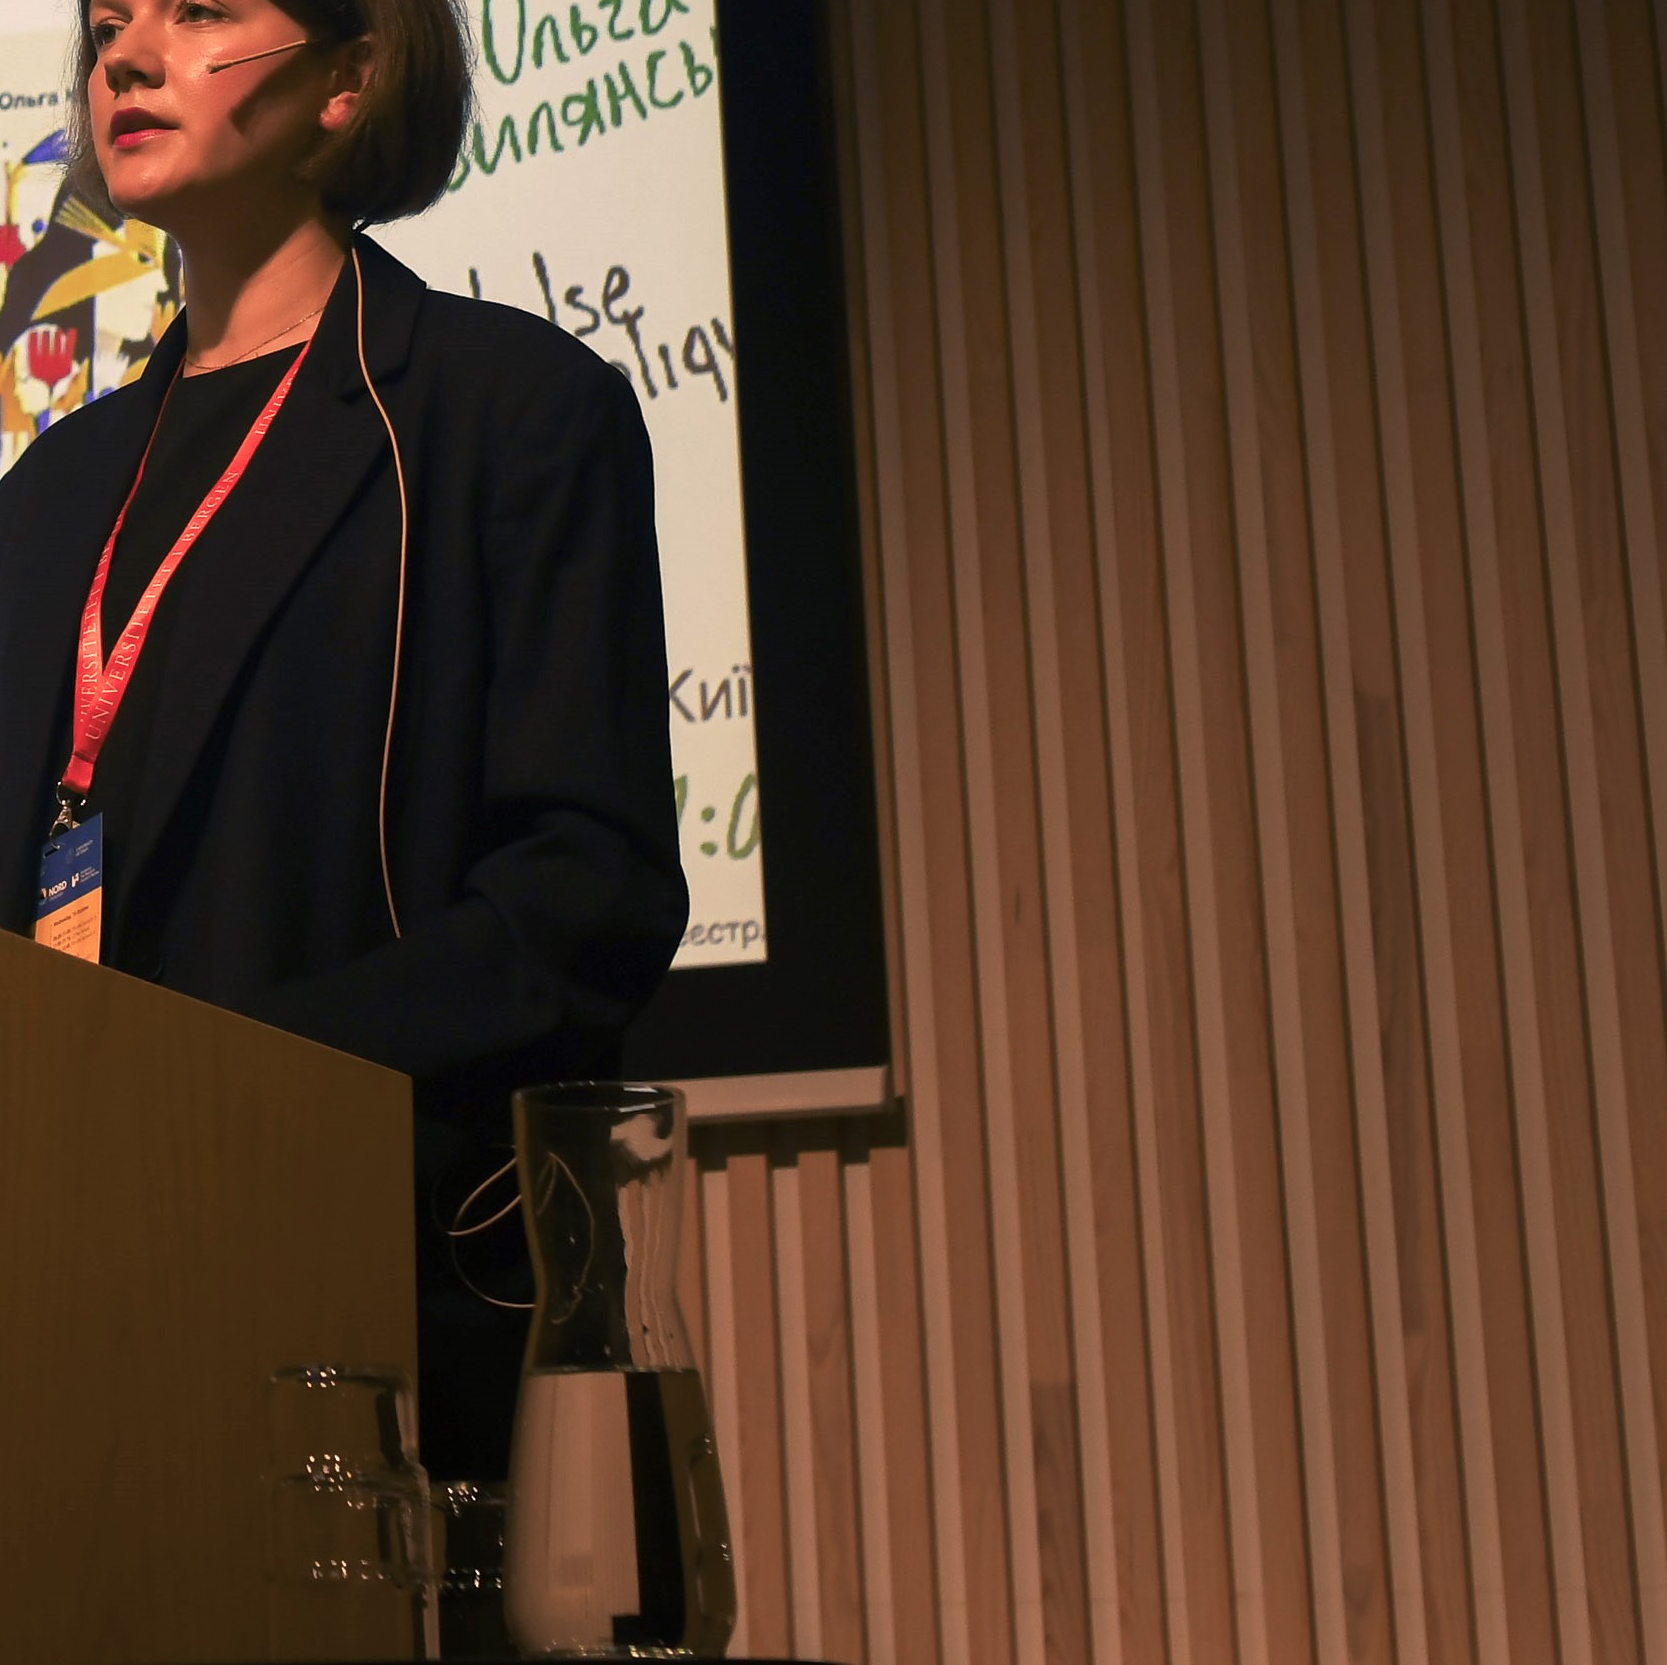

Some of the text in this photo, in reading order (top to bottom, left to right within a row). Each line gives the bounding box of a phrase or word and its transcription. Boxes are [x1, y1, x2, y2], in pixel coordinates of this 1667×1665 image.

[85, 563, 173, 740] UNIVERSITETET
[181, 470, 240, 545] BERGEN
[49, 880, 68, 897] NORD
